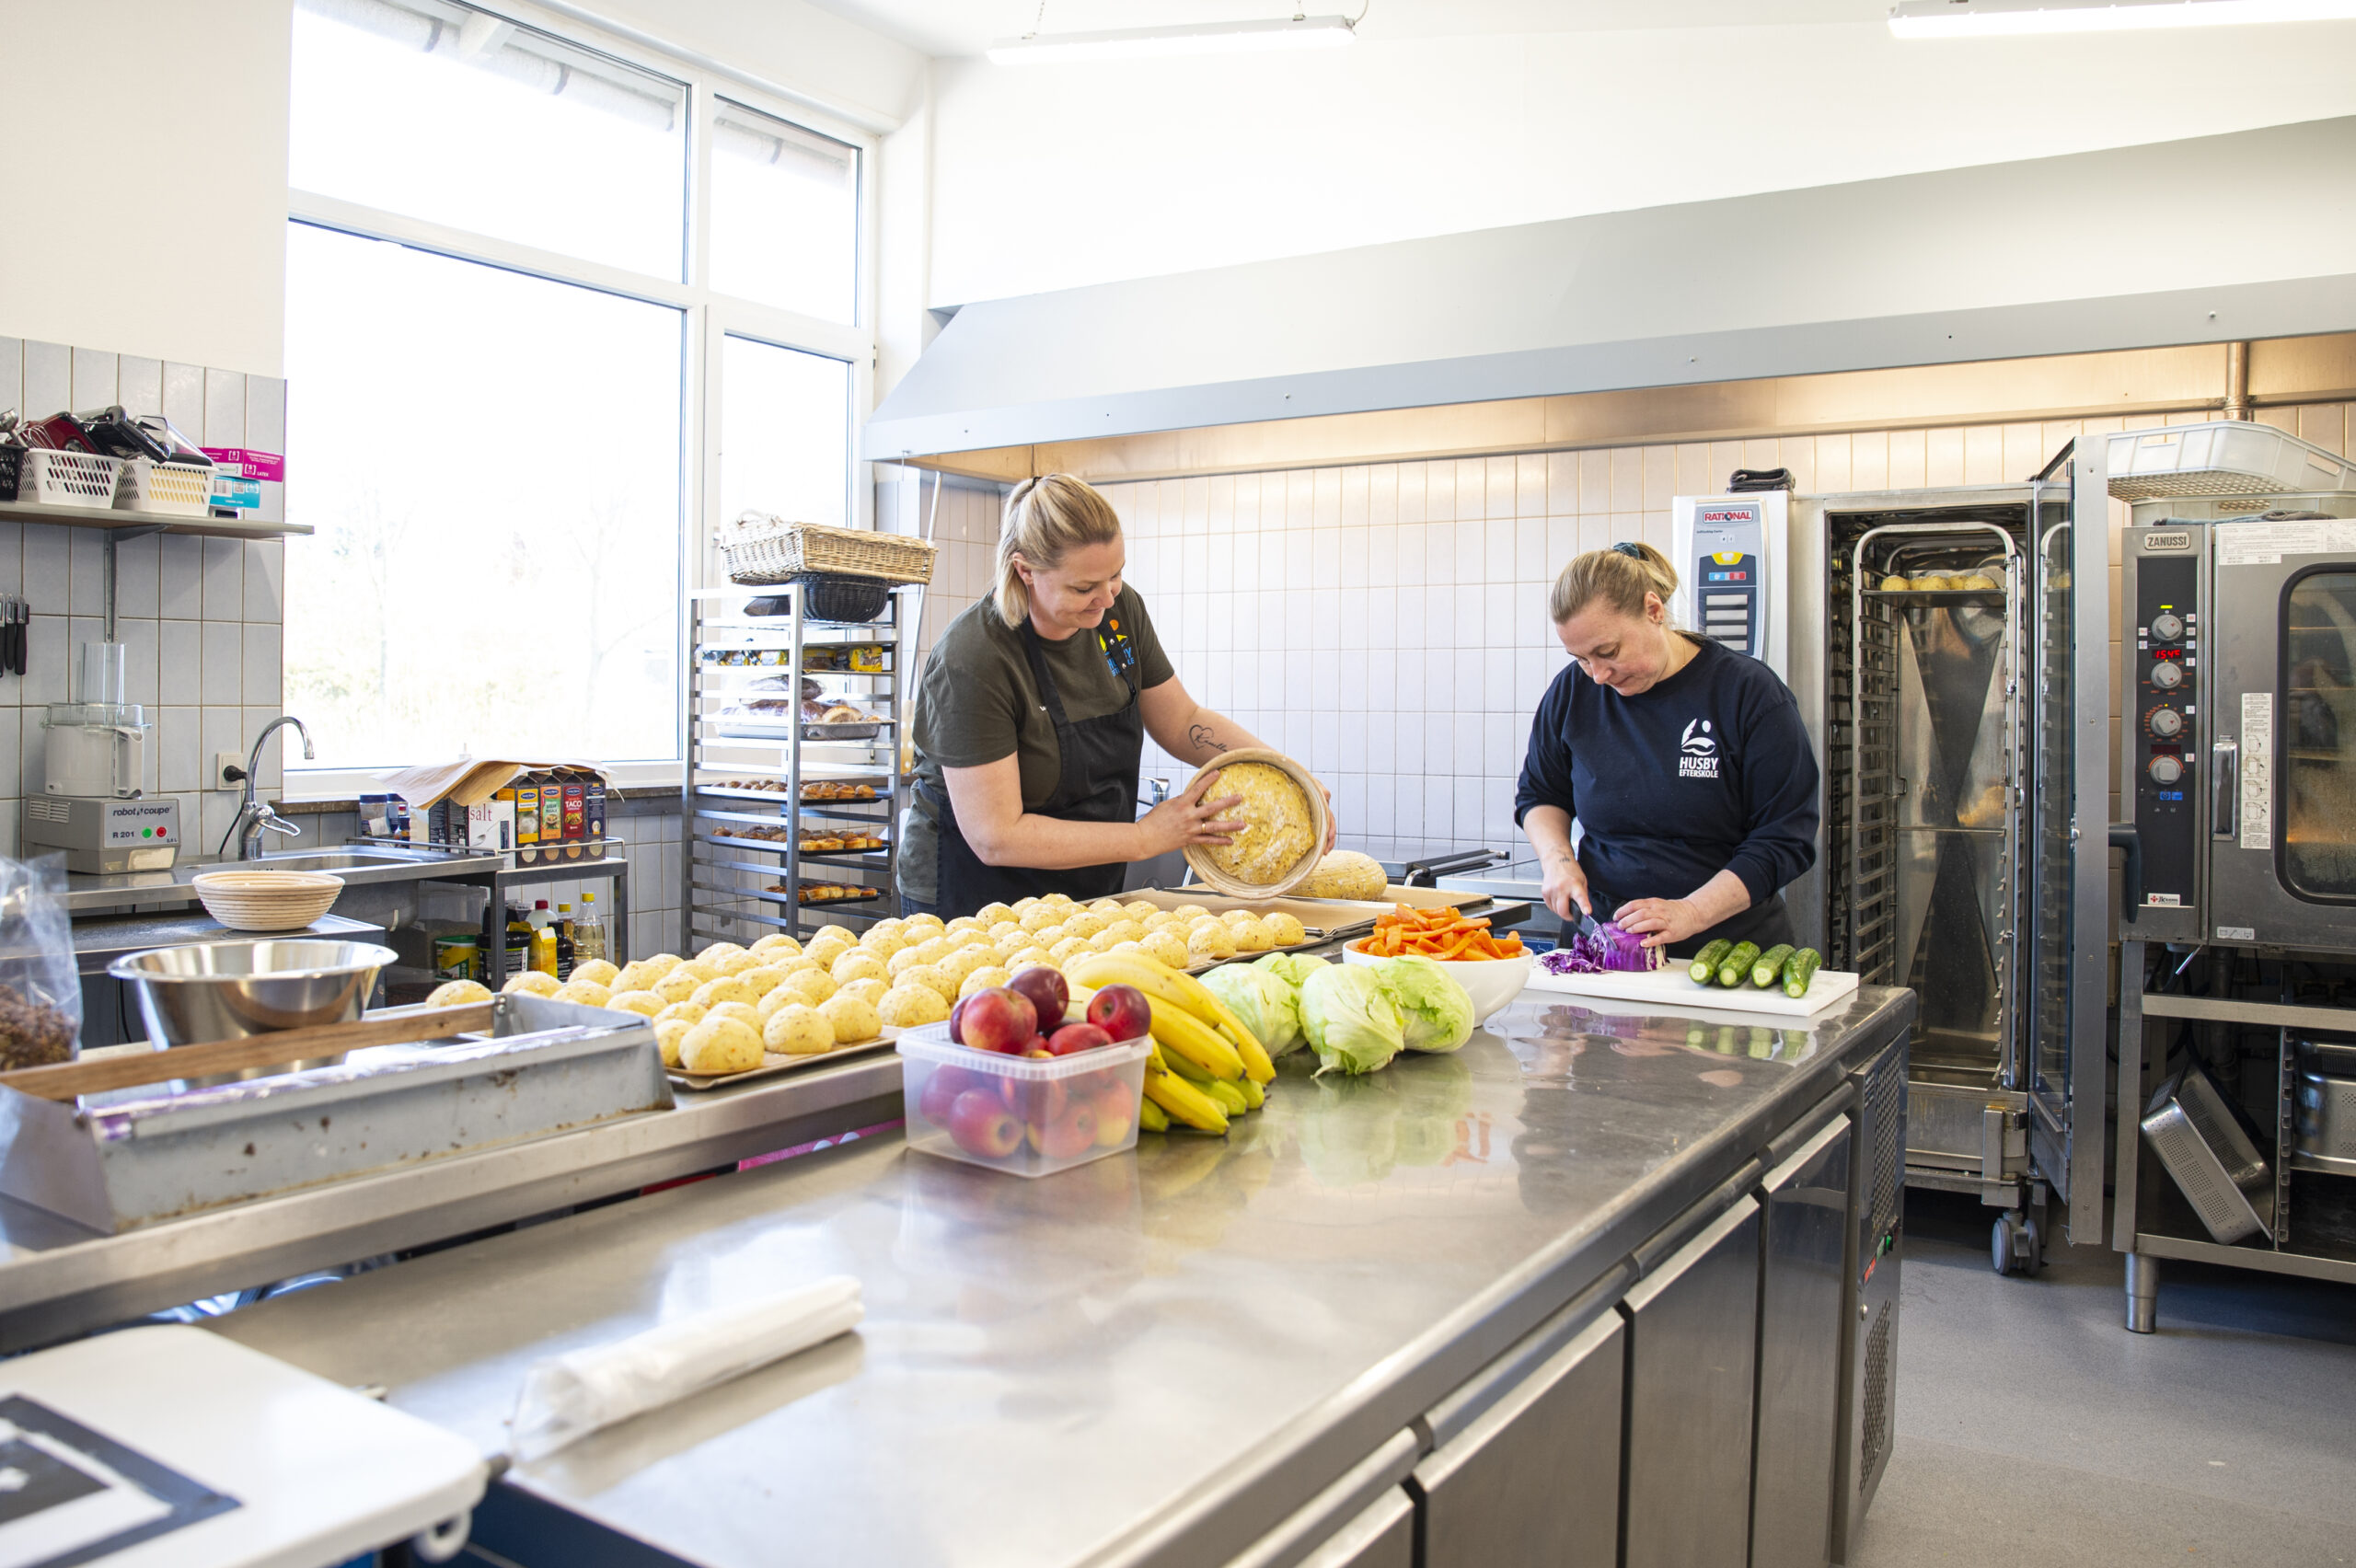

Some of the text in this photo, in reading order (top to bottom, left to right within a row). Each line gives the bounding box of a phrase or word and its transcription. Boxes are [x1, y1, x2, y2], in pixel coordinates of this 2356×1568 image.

[1703, 512, 1751, 522] RATIONAL
[2147, 536, 2188, 547] ZANUSSI
[1679, 756, 1718, 770] HUSBY
[1679, 768, 1718, 778] EFTERSKOLE
[564, 800, 583, 808] TACO
[112, 806, 170, 816] robot coupe
[469, 802, 492, 822] salt
